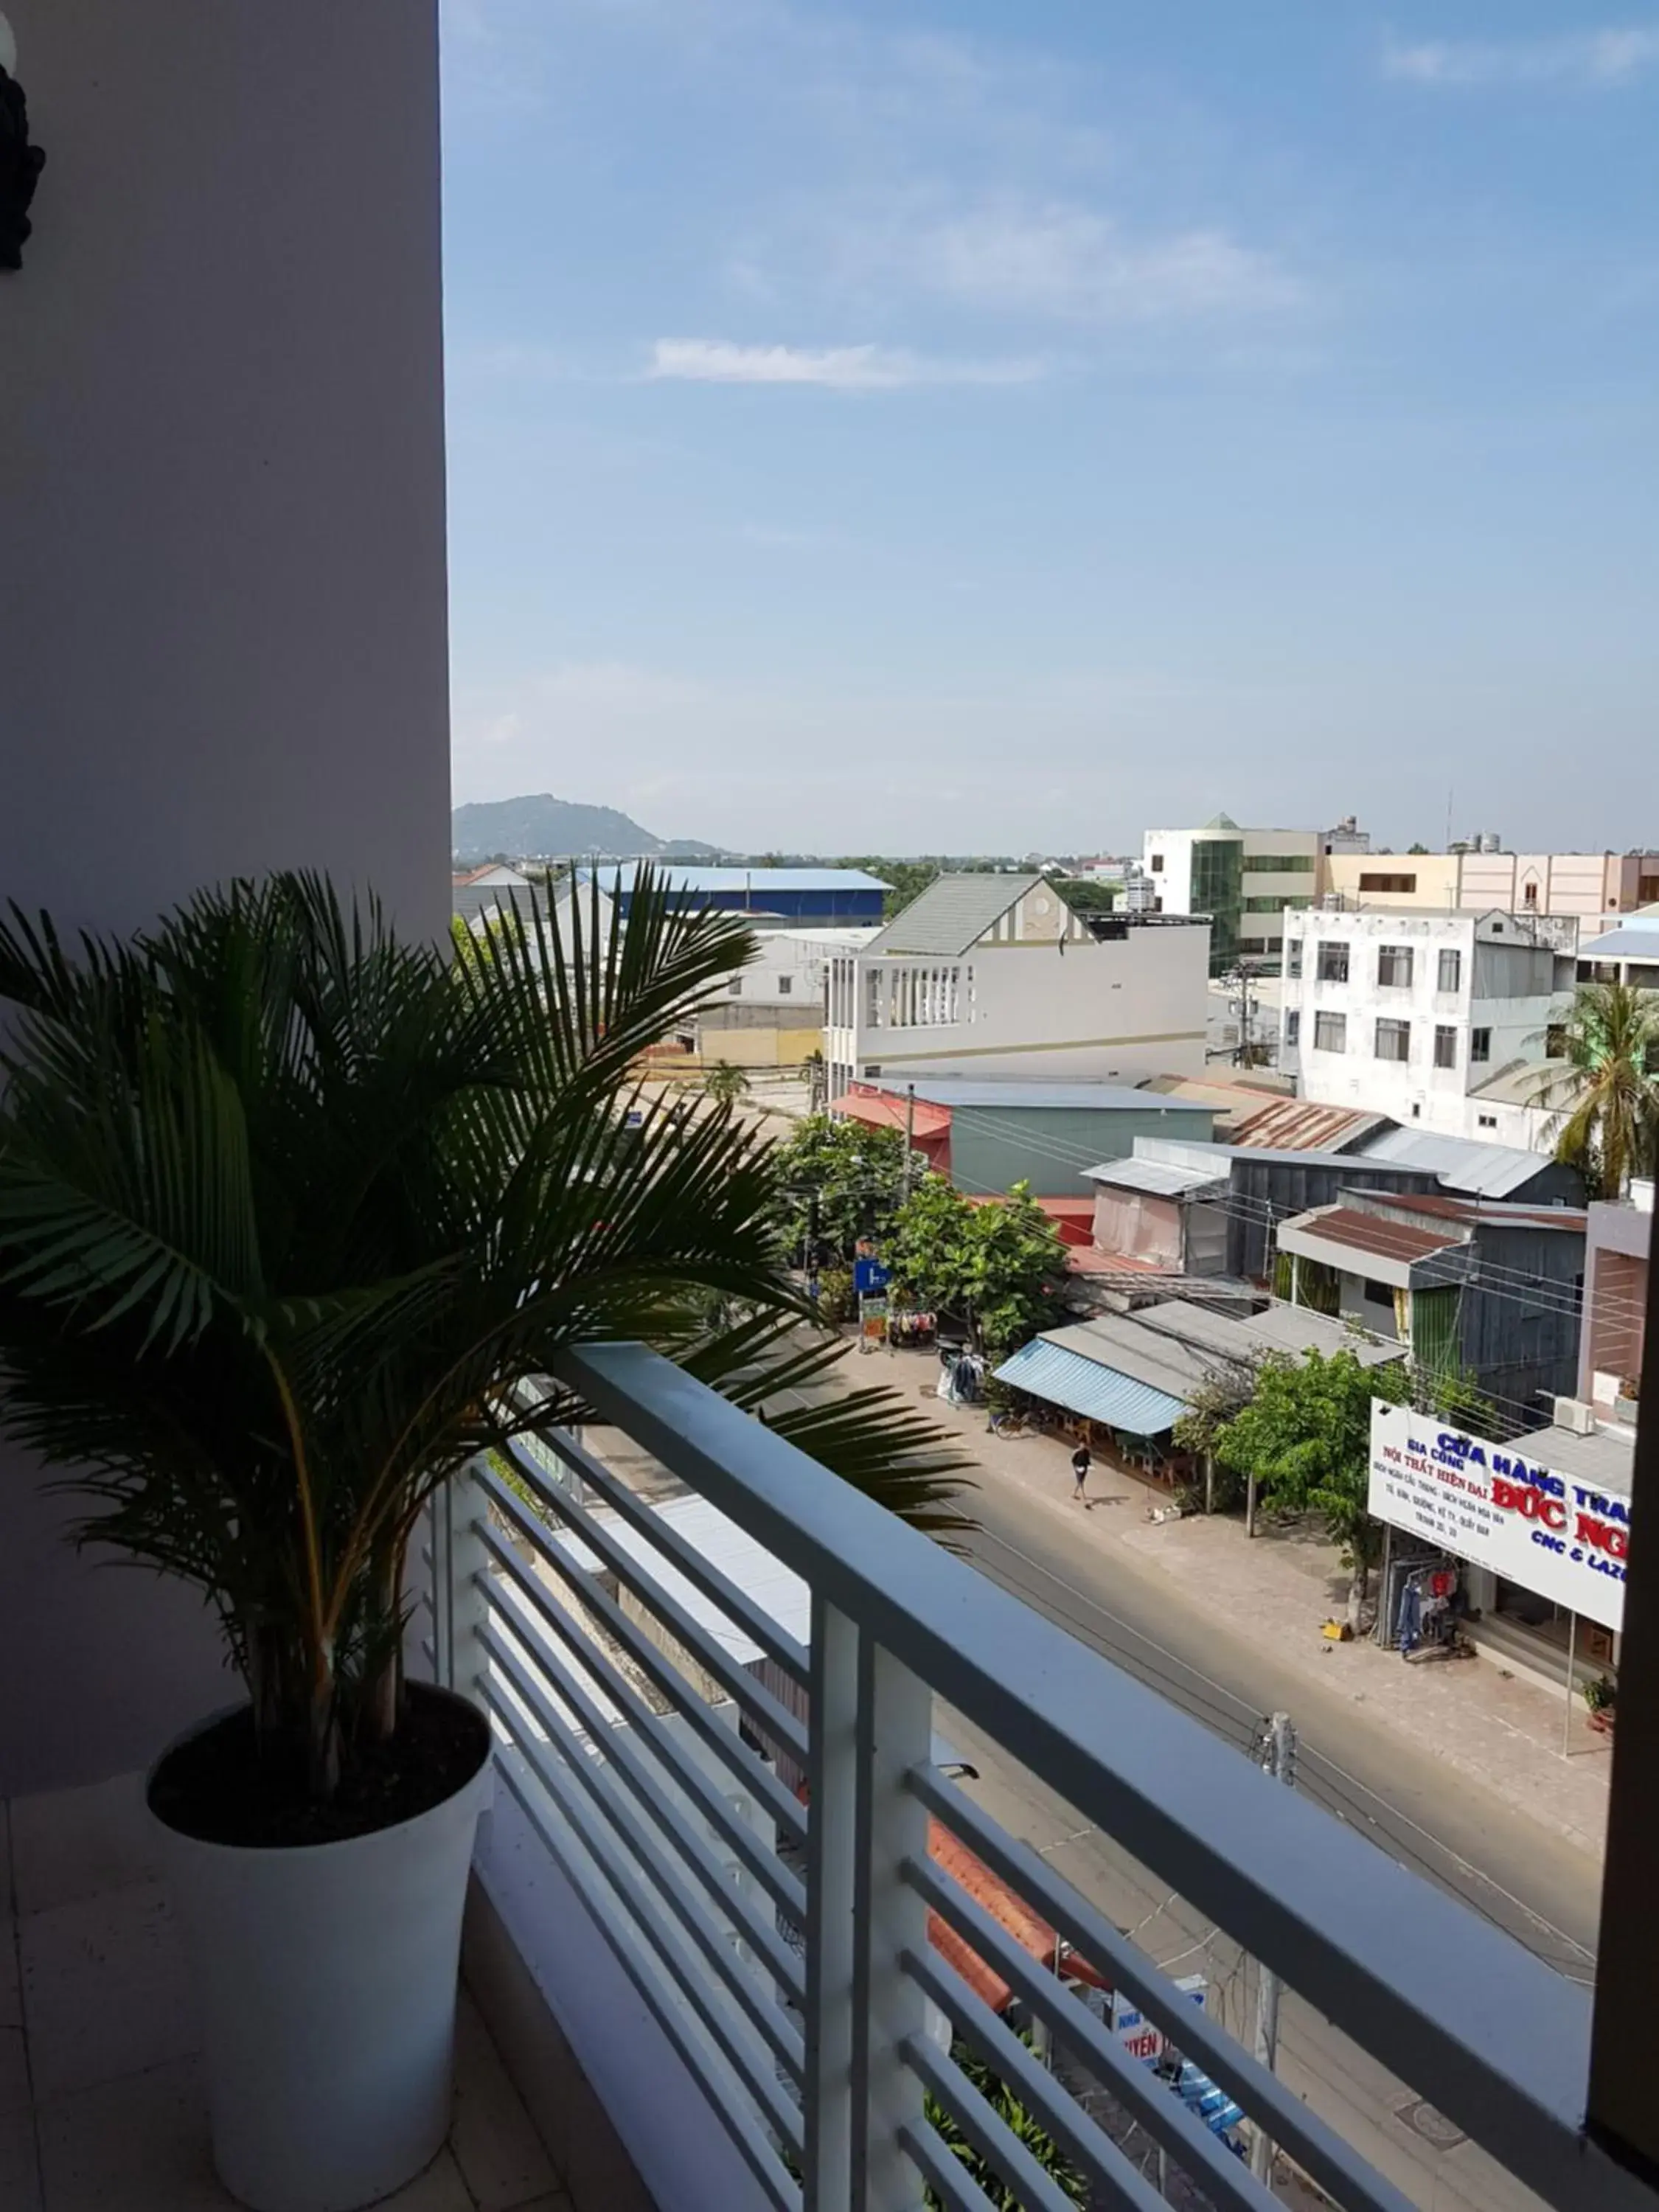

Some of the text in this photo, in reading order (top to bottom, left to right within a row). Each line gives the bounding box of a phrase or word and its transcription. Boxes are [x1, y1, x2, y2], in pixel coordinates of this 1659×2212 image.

[1382, 1445, 1402, 1464] NỘI
[1404, 1452, 1433, 1477] THẤT
[1468, 1482, 1489, 1500] ĐẠI
[1407, 1438, 1464, 1472] GIA CÔNG
[1492, 1453, 1565, 1498] HÀNG
[1491, 1476, 1628, 1559] ĐỨC NG
[1531, 1529, 1565, 1554] CNC
[1569, 1547, 1583, 1562] &
